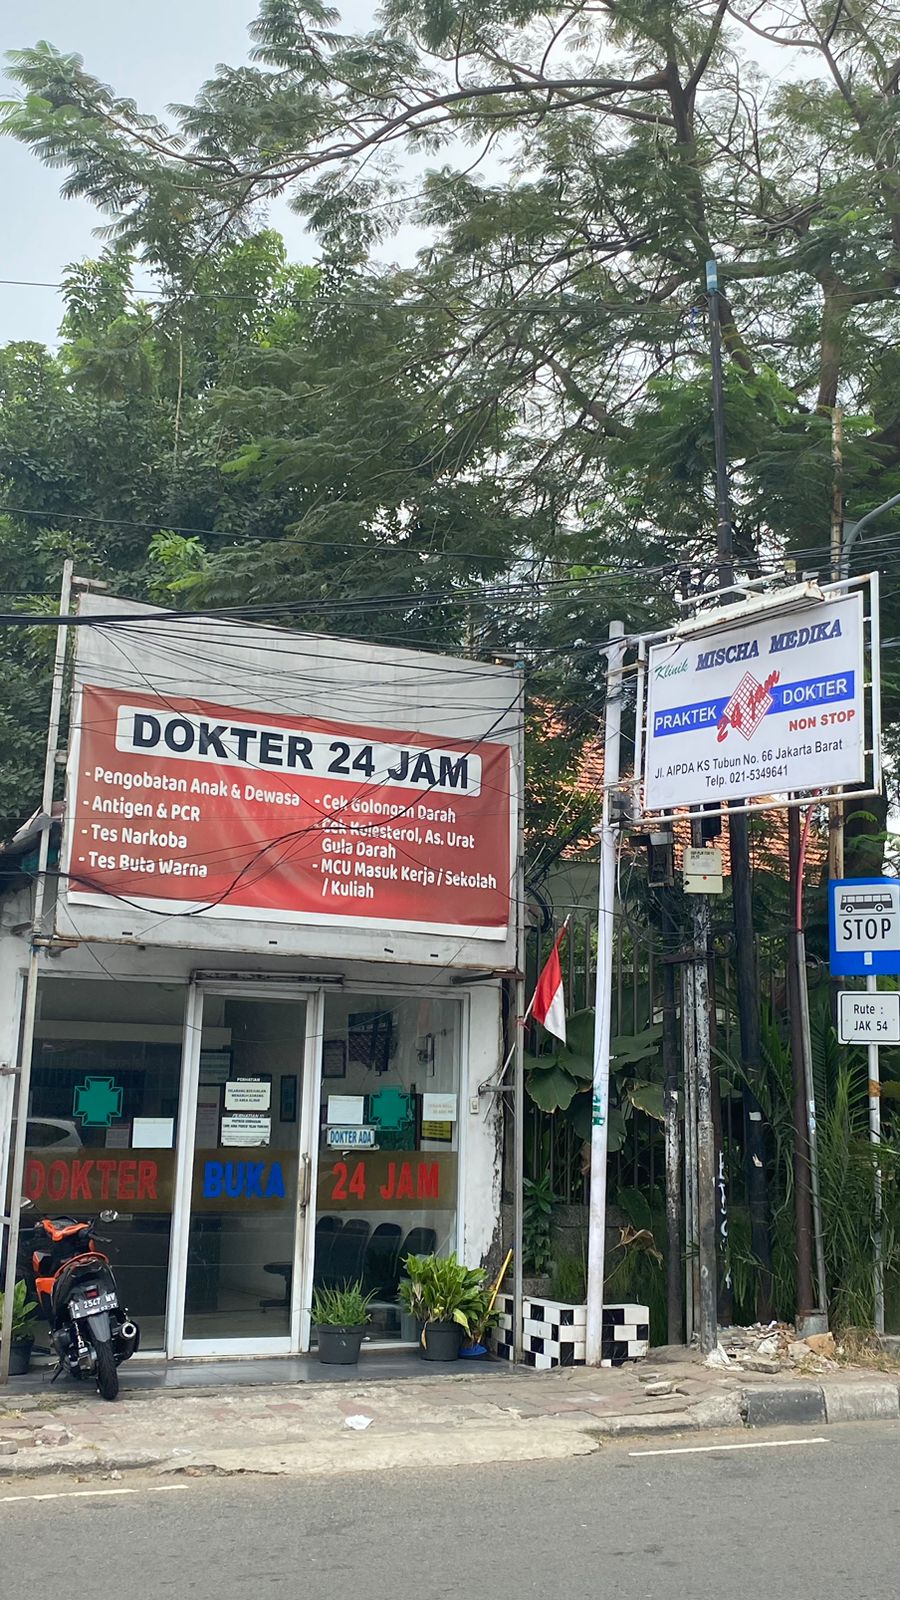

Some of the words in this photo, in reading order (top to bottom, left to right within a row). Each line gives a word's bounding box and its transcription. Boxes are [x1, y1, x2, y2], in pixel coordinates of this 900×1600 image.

[655, 657, 689, 681] Klinik
[695, 640, 760, 672] MISCHA
[768, 619, 843, 655] MEDIKA
[655, 706, 717, 731] PRAKTEK
[783, 678, 848, 705] DOKTER
[789, 716, 816, 732] NON
[820, 709, 856, 726] STOP
[133, 713, 314, 770] DOKTER
[328, 741, 375, 777] 24
[388, 750, 469, 790] JAM
[666, 764, 695, 777] AIPDA
[697, 760, 710, 772] KS
[713, 756, 741, 770] Tubun
[743, 753, 759, 767] No.
[762, 750, 773, 762] 66
[776, 744, 812, 760] Jakarta
[815, 739, 843, 754] Barat
[94, 766, 187, 792] Pengobatan
[190, 778, 227, 797] Anak
[231, 783, 241, 799] &
[244, 785, 300, 807] Dewasa
[706, 774, 727, 788] Telp.
[730, 765, 788, 783] 021-5349641
[92, 795, 153, 820] Antigen
[156, 803, 168, 819] &
[171, 804, 201, 822] PCR
[323, 794, 348, 810] Cek
[351, 798, 415, 818] Golongan
[418, 805, 456, 824] Darah
[91, 823, 117, 842] Tes
[121, 827, 187, 849] Narkoba
[322, 838, 352, 855] Gula
[356, 841, 396, 859] Darah
[425, 830, 444, 845] As.
[447, 831, 475, 849] Urat
[88, 851, 116, 869] Tes
[119, 854, 154, 873] Buta
[158, 858, 208, 878] Warna
[321, 858, 352, 875] MCU
[354, 863, 398, 881] Masuk
[400, 866, 435, 886] Kerja
[445, 870, 497, 889] Sekolah
[331, 881, 374, 898] Kuliah
[843, 918, 892, 940] STOP
[853, 1004, 875, 1015] Rute
[854, 1021, 871, 1031] JAK
[876, 1020, 888, 1031] 54
[330, 1130, 357, 1144] DOKTER
[358, 1130, 372, 1144] ADA
[24, 1159, 158, 1200] DOKTER
[203, 1160, 286, 1199] BUKA
[331, 1161, 366, 1201] 24
[379, 1161, 441, 1201] JAM
